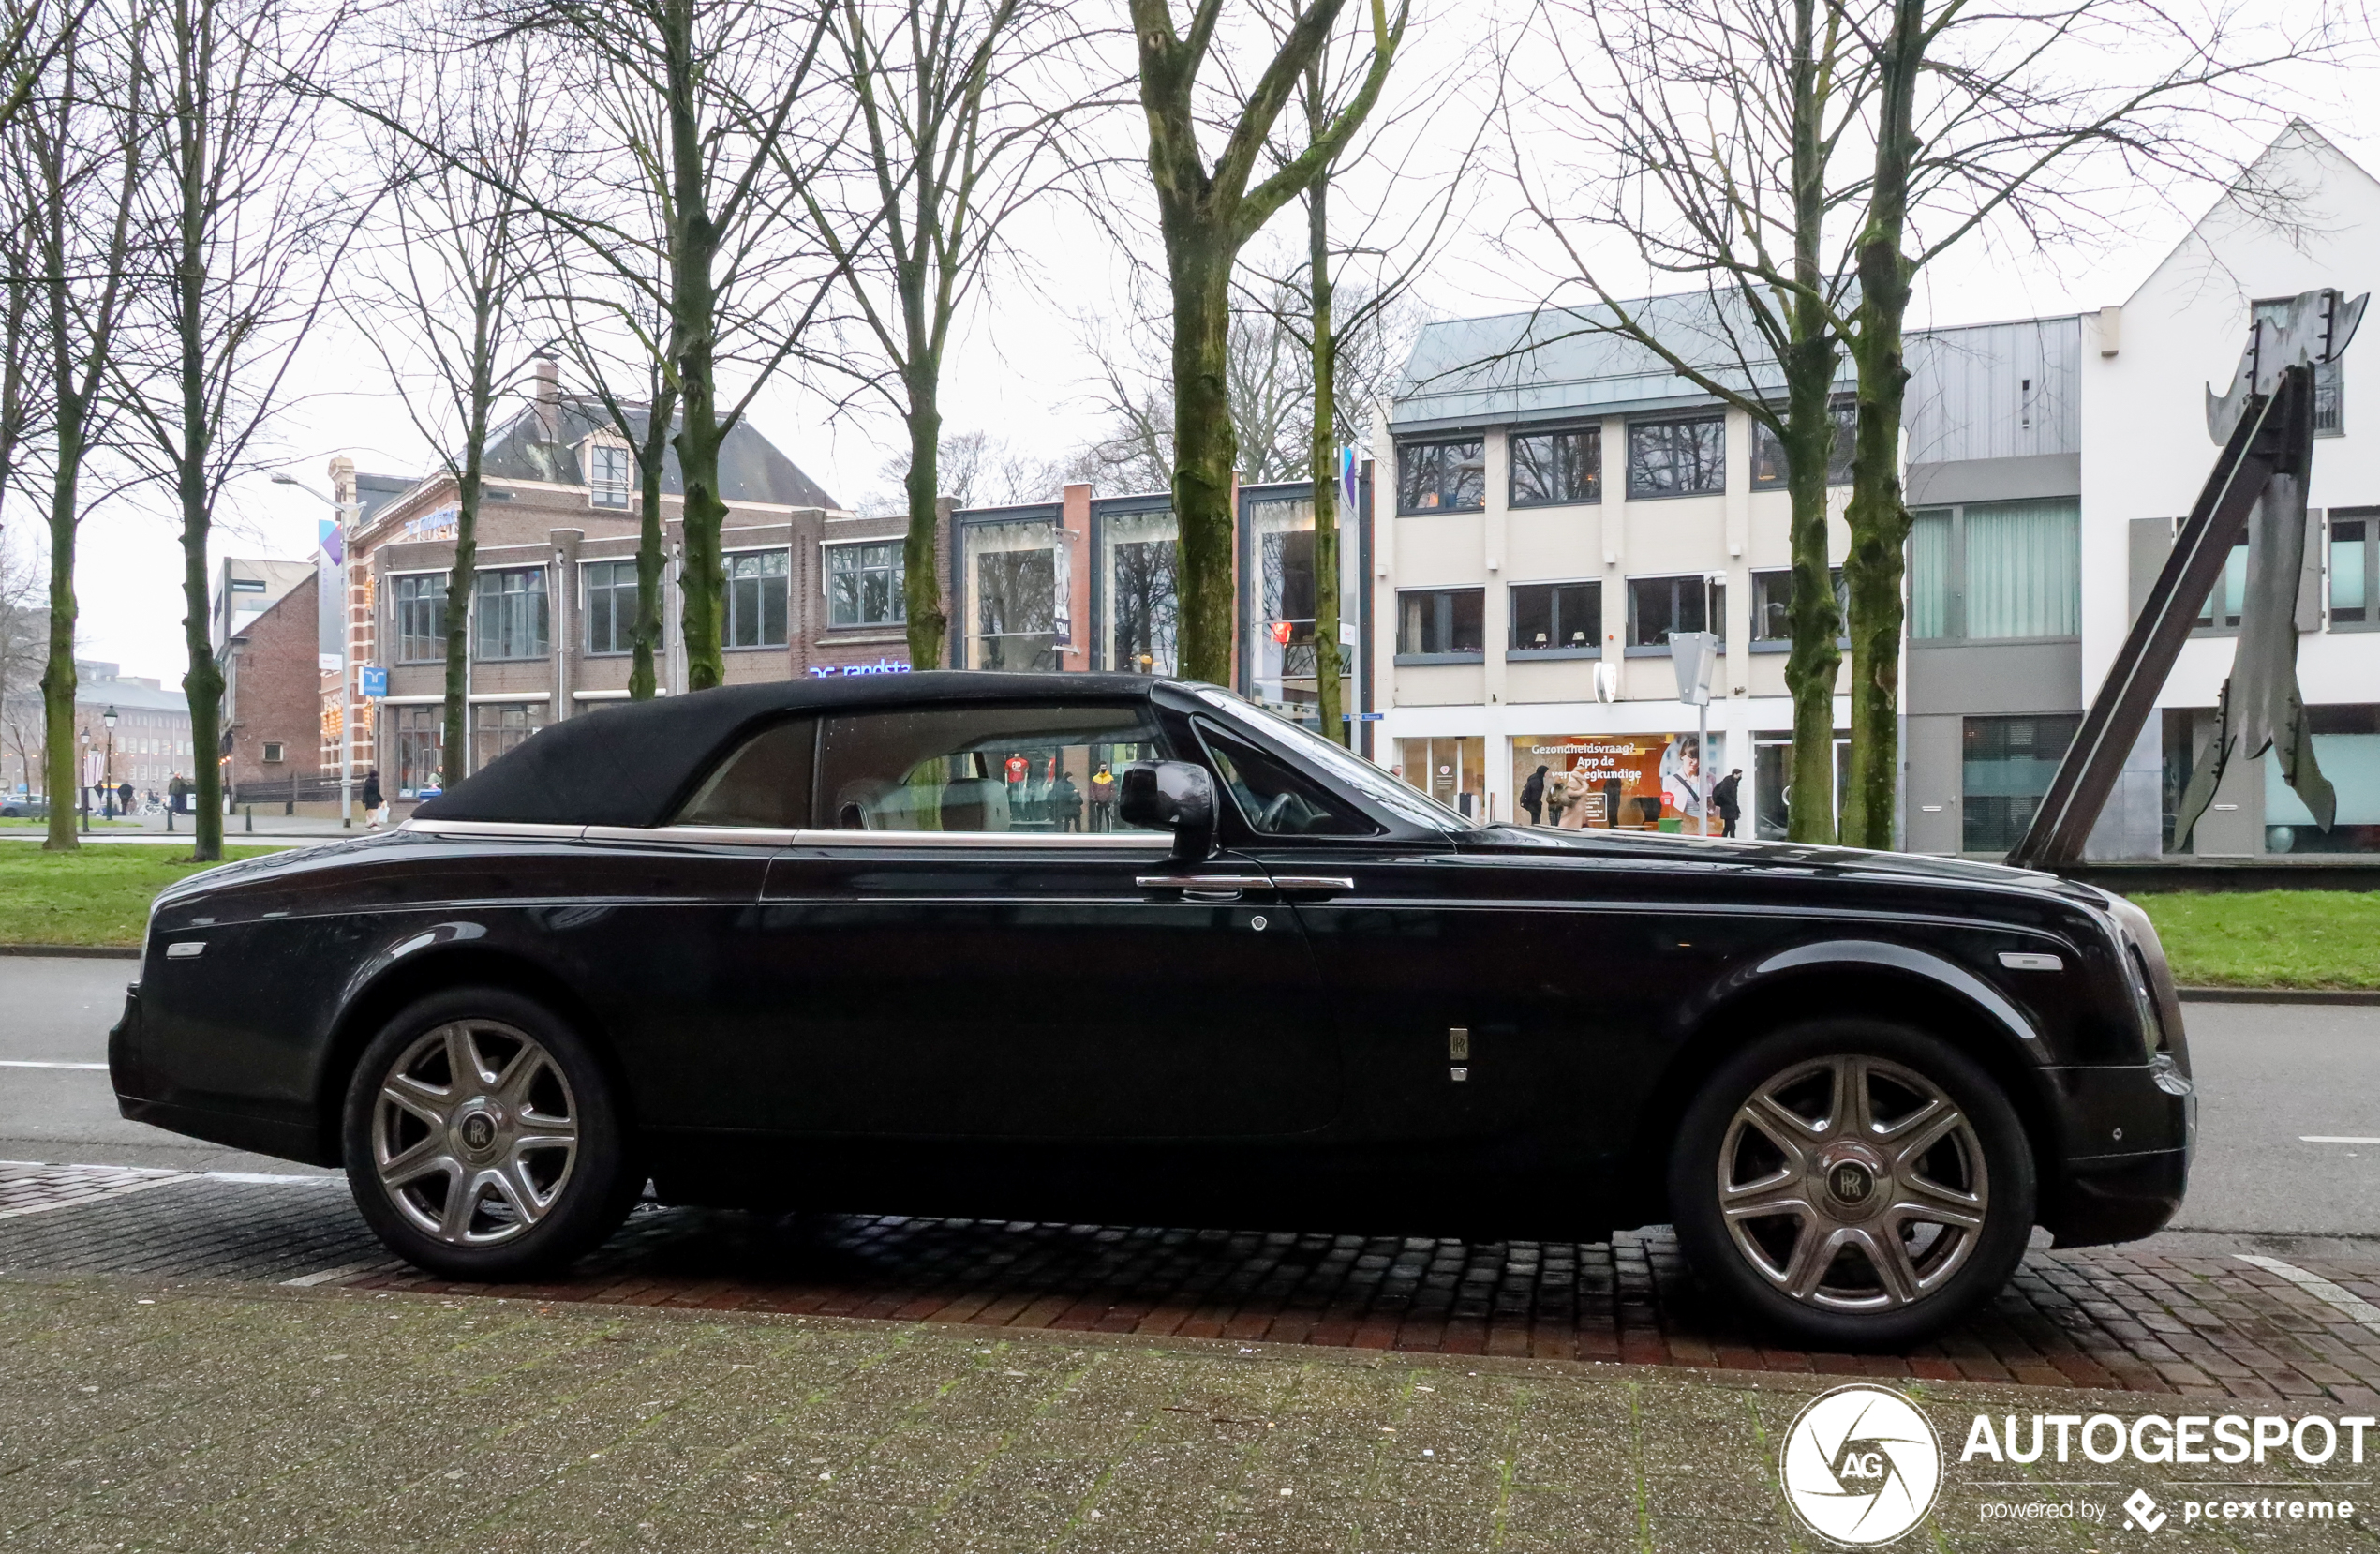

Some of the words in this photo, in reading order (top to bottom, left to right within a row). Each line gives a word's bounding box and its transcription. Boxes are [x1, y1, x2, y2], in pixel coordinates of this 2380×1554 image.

[843, 659, 912, 676] randsta
[1531, 742, 1635, 755] Gezondheidsvraag?
[1577, 756, 1599, 769] App
[1600, 755, 1614, 766] de
[1552, 769, 1642, 782] verpegkundige
